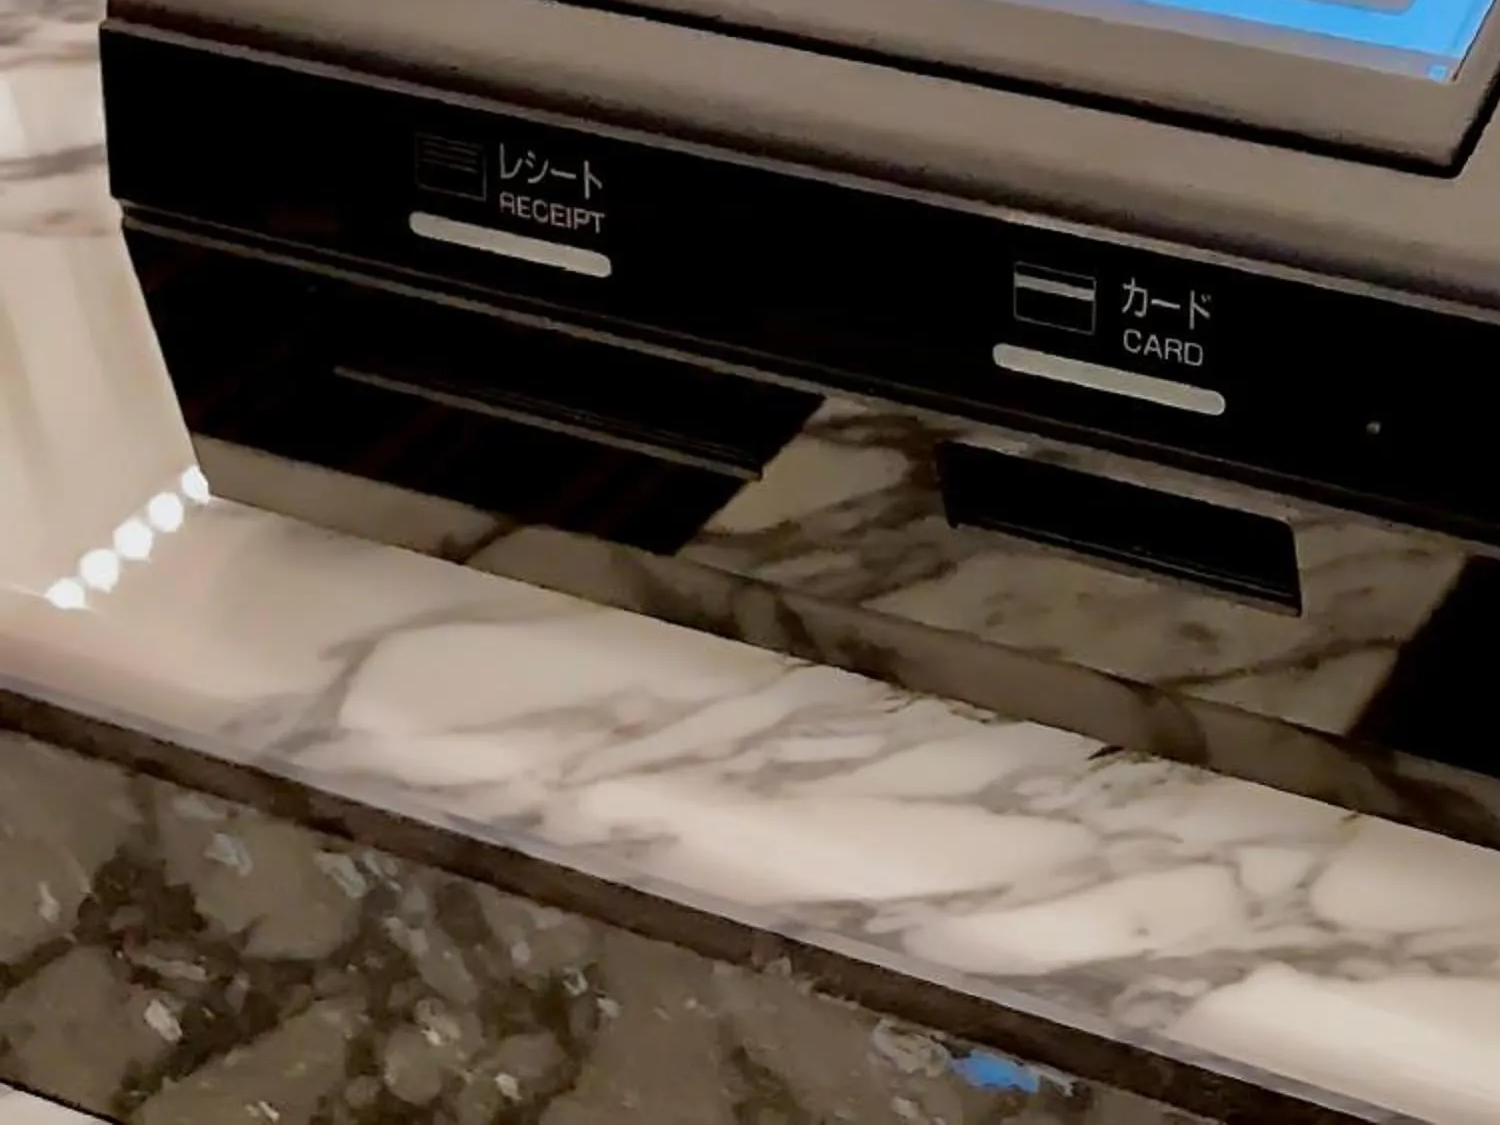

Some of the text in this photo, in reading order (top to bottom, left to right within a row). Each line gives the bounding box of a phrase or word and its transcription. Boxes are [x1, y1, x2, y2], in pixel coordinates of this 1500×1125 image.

[499, 142, 604, 200] レシート
[499, 191, 606, 234] RECEIPT
[1121, 277, 1212, 330] カード
[1123, 328, 1204, 367] CARD
